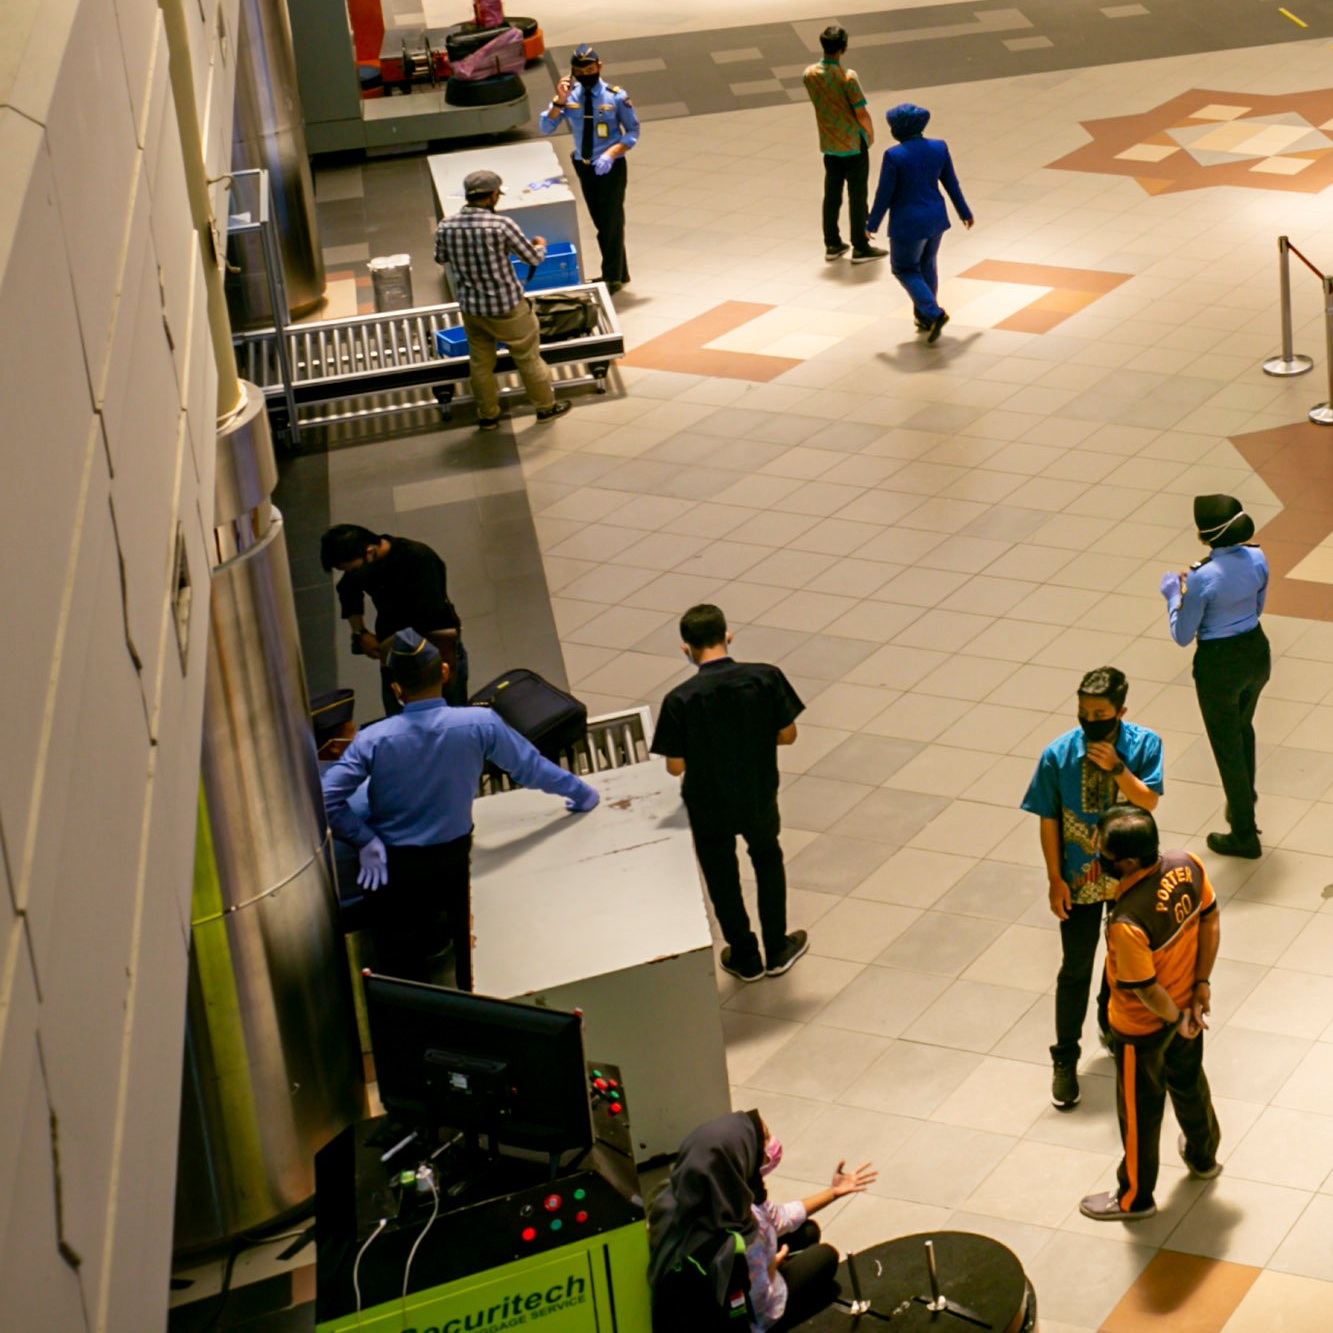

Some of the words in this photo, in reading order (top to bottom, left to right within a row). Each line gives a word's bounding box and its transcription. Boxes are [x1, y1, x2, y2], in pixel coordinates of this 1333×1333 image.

[1156, 866, 1193, 912] PORTER
[1174, 894, 1192, 924] 60
[531, 1295, 586, 1319] SERVICE
